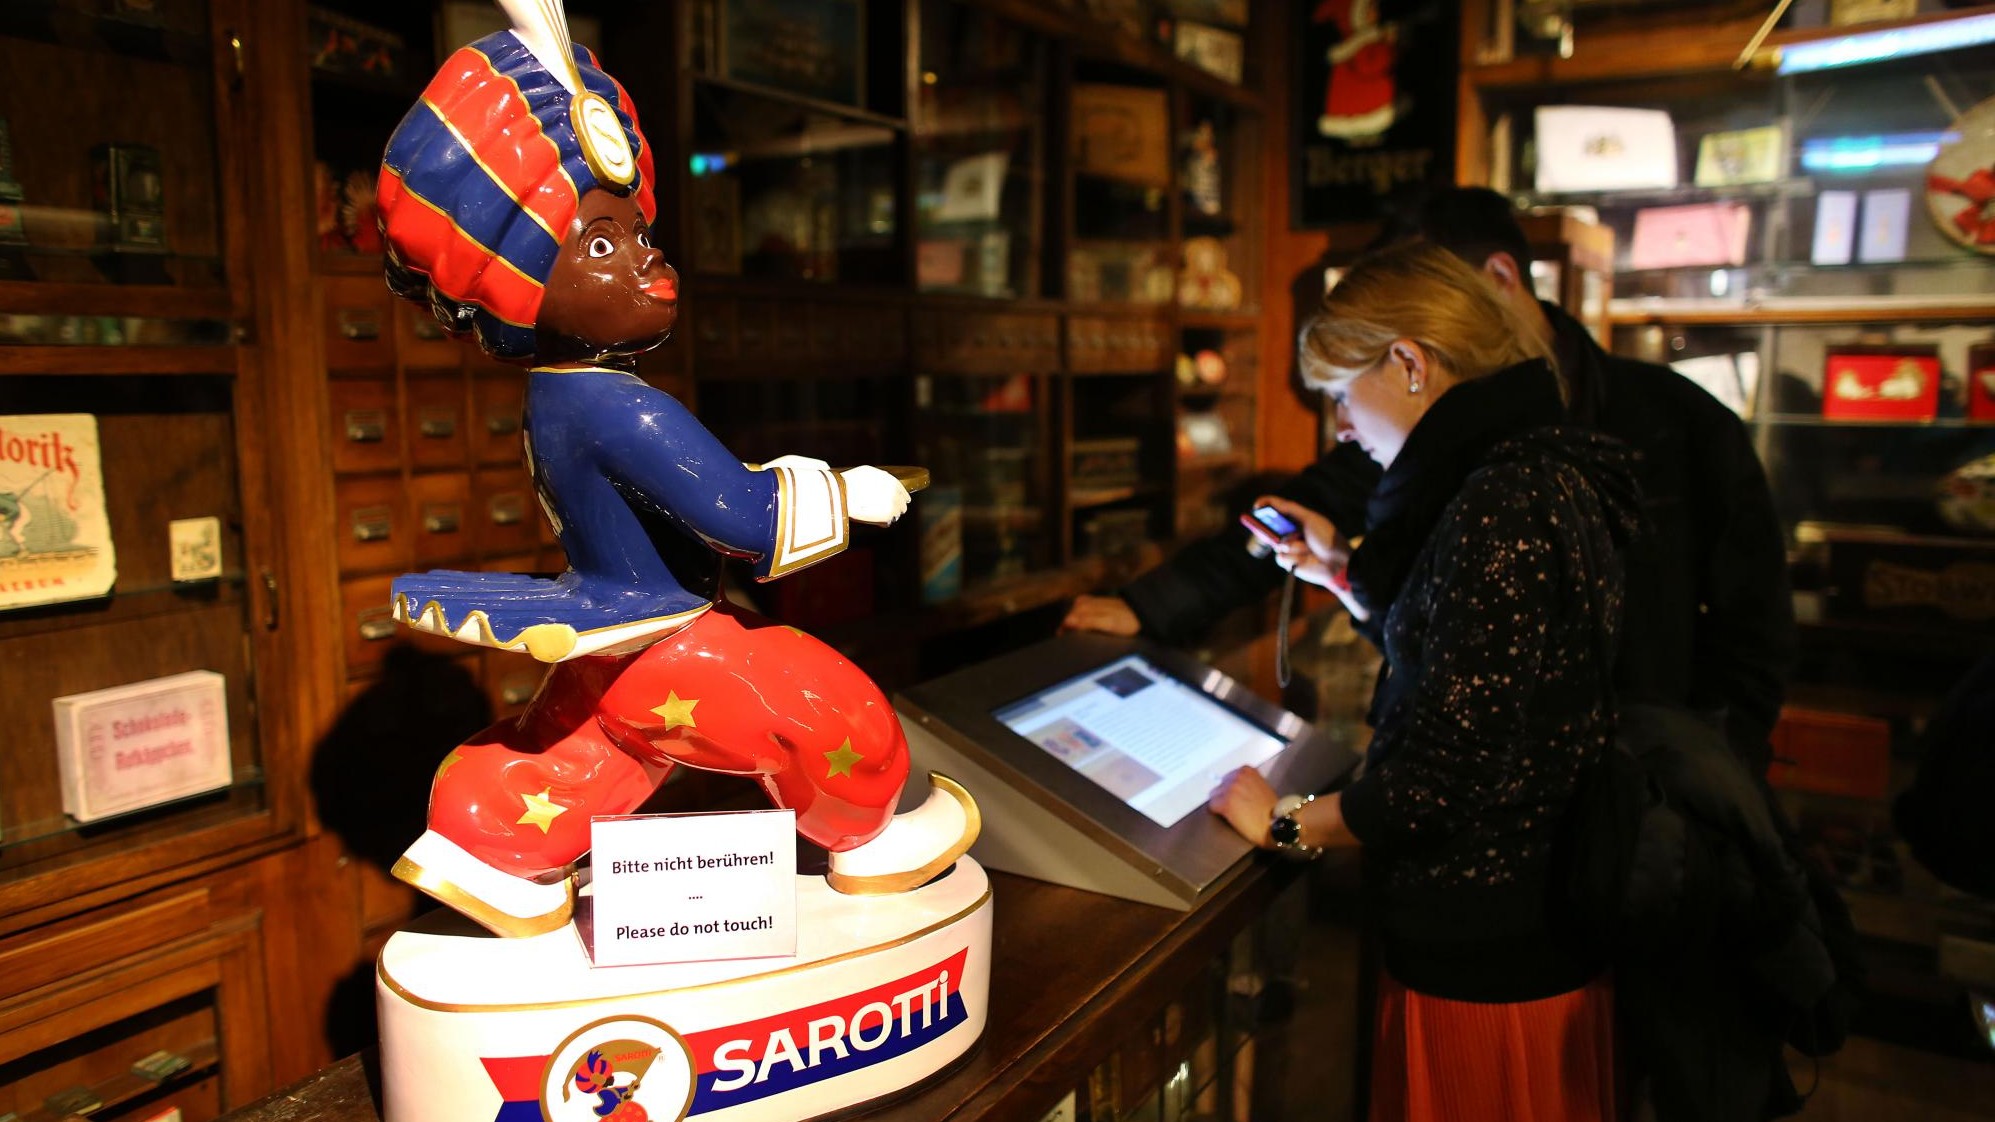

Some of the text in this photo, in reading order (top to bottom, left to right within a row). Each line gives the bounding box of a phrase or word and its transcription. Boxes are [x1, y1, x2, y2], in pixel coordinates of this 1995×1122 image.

[612, 851, 774, 874] Bitte nicht berühren!
[617, 915, 773, 940] Please do not touch!
